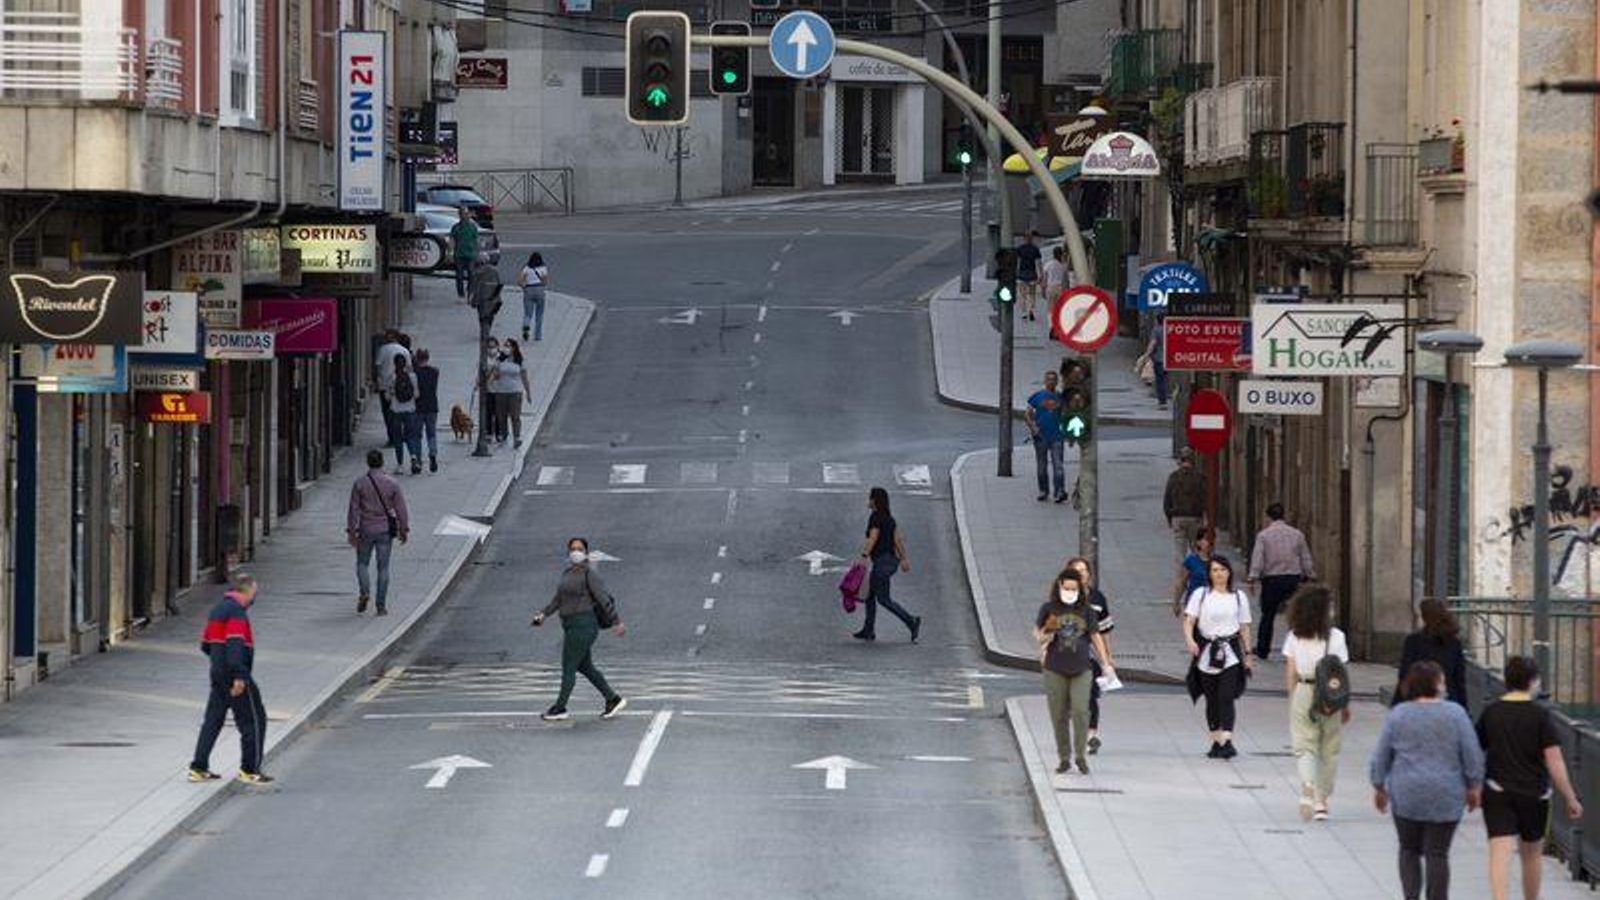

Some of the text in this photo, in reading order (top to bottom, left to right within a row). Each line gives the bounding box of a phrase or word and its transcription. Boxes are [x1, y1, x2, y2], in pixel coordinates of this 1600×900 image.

[350, 55, 373, 85] 21
[288, 228, 367, 241] CORTINAS
[178, 252, 233, 273] ALPINA
[28, 297, 97, 312] Rivendel
[1167, 325, 1200, 335] FOTO
[209, 334, 271, 348] COMIDAS
[1174, 351, 1225, 363] DIGITAL
[134, 374, 189, 386] UNISEX
[1247, 390, 1316, 406] O BUXO
